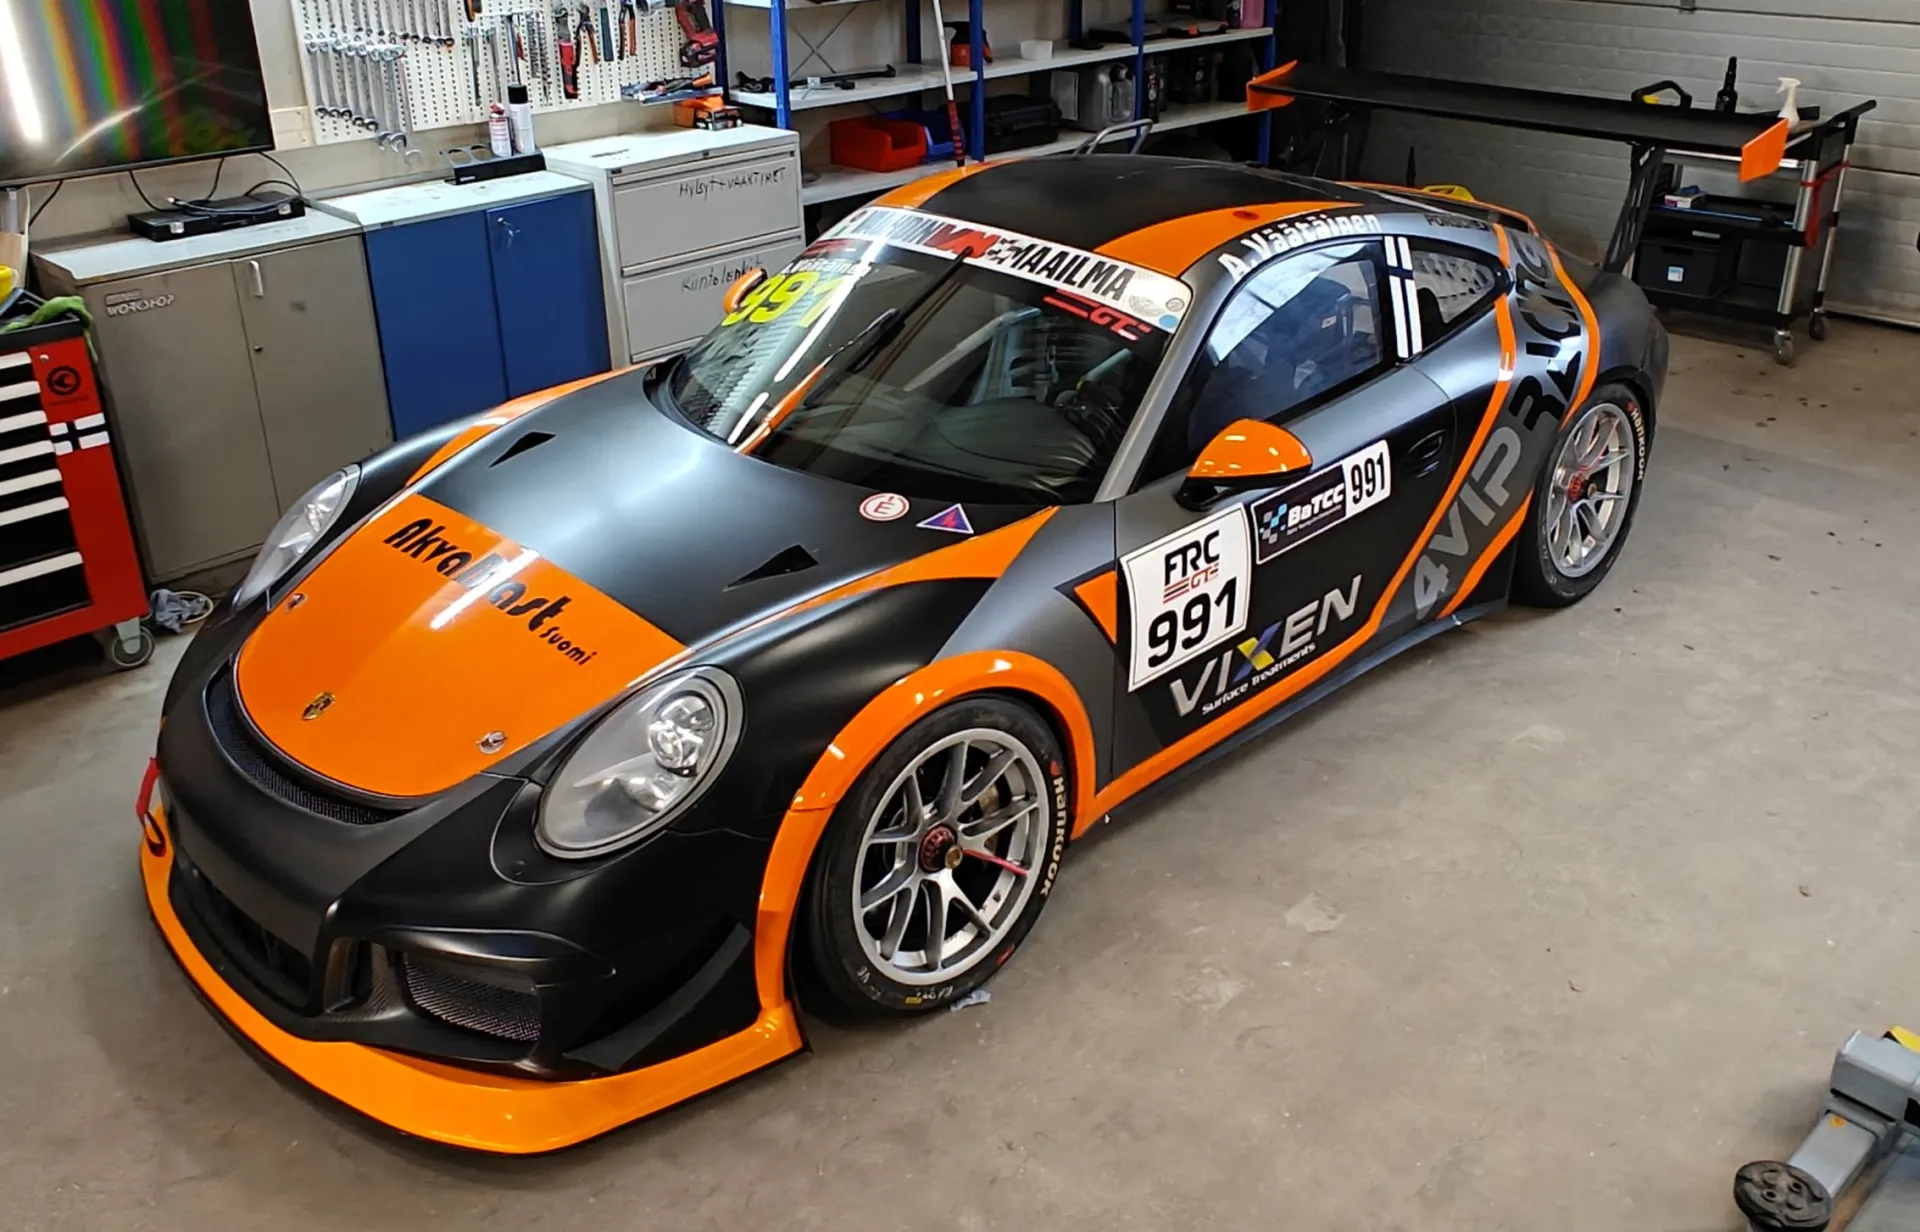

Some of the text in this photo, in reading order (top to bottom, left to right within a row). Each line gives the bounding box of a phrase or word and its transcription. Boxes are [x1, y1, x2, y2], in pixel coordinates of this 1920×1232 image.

[721, 270, 847, 329] 991
[1005, 242, 1137, 302] MAAILMA
[1286, 483, 1345, 528] BaTCC
[1350, 451, 1386, 505] 991
[1163, 529, 1221, 587] FRC
[1147, 575, 1239, 669] 991
[1169, 574, 1363, 718] VIXEN
[1202, 641, 1317, 715] Surface Treatments
